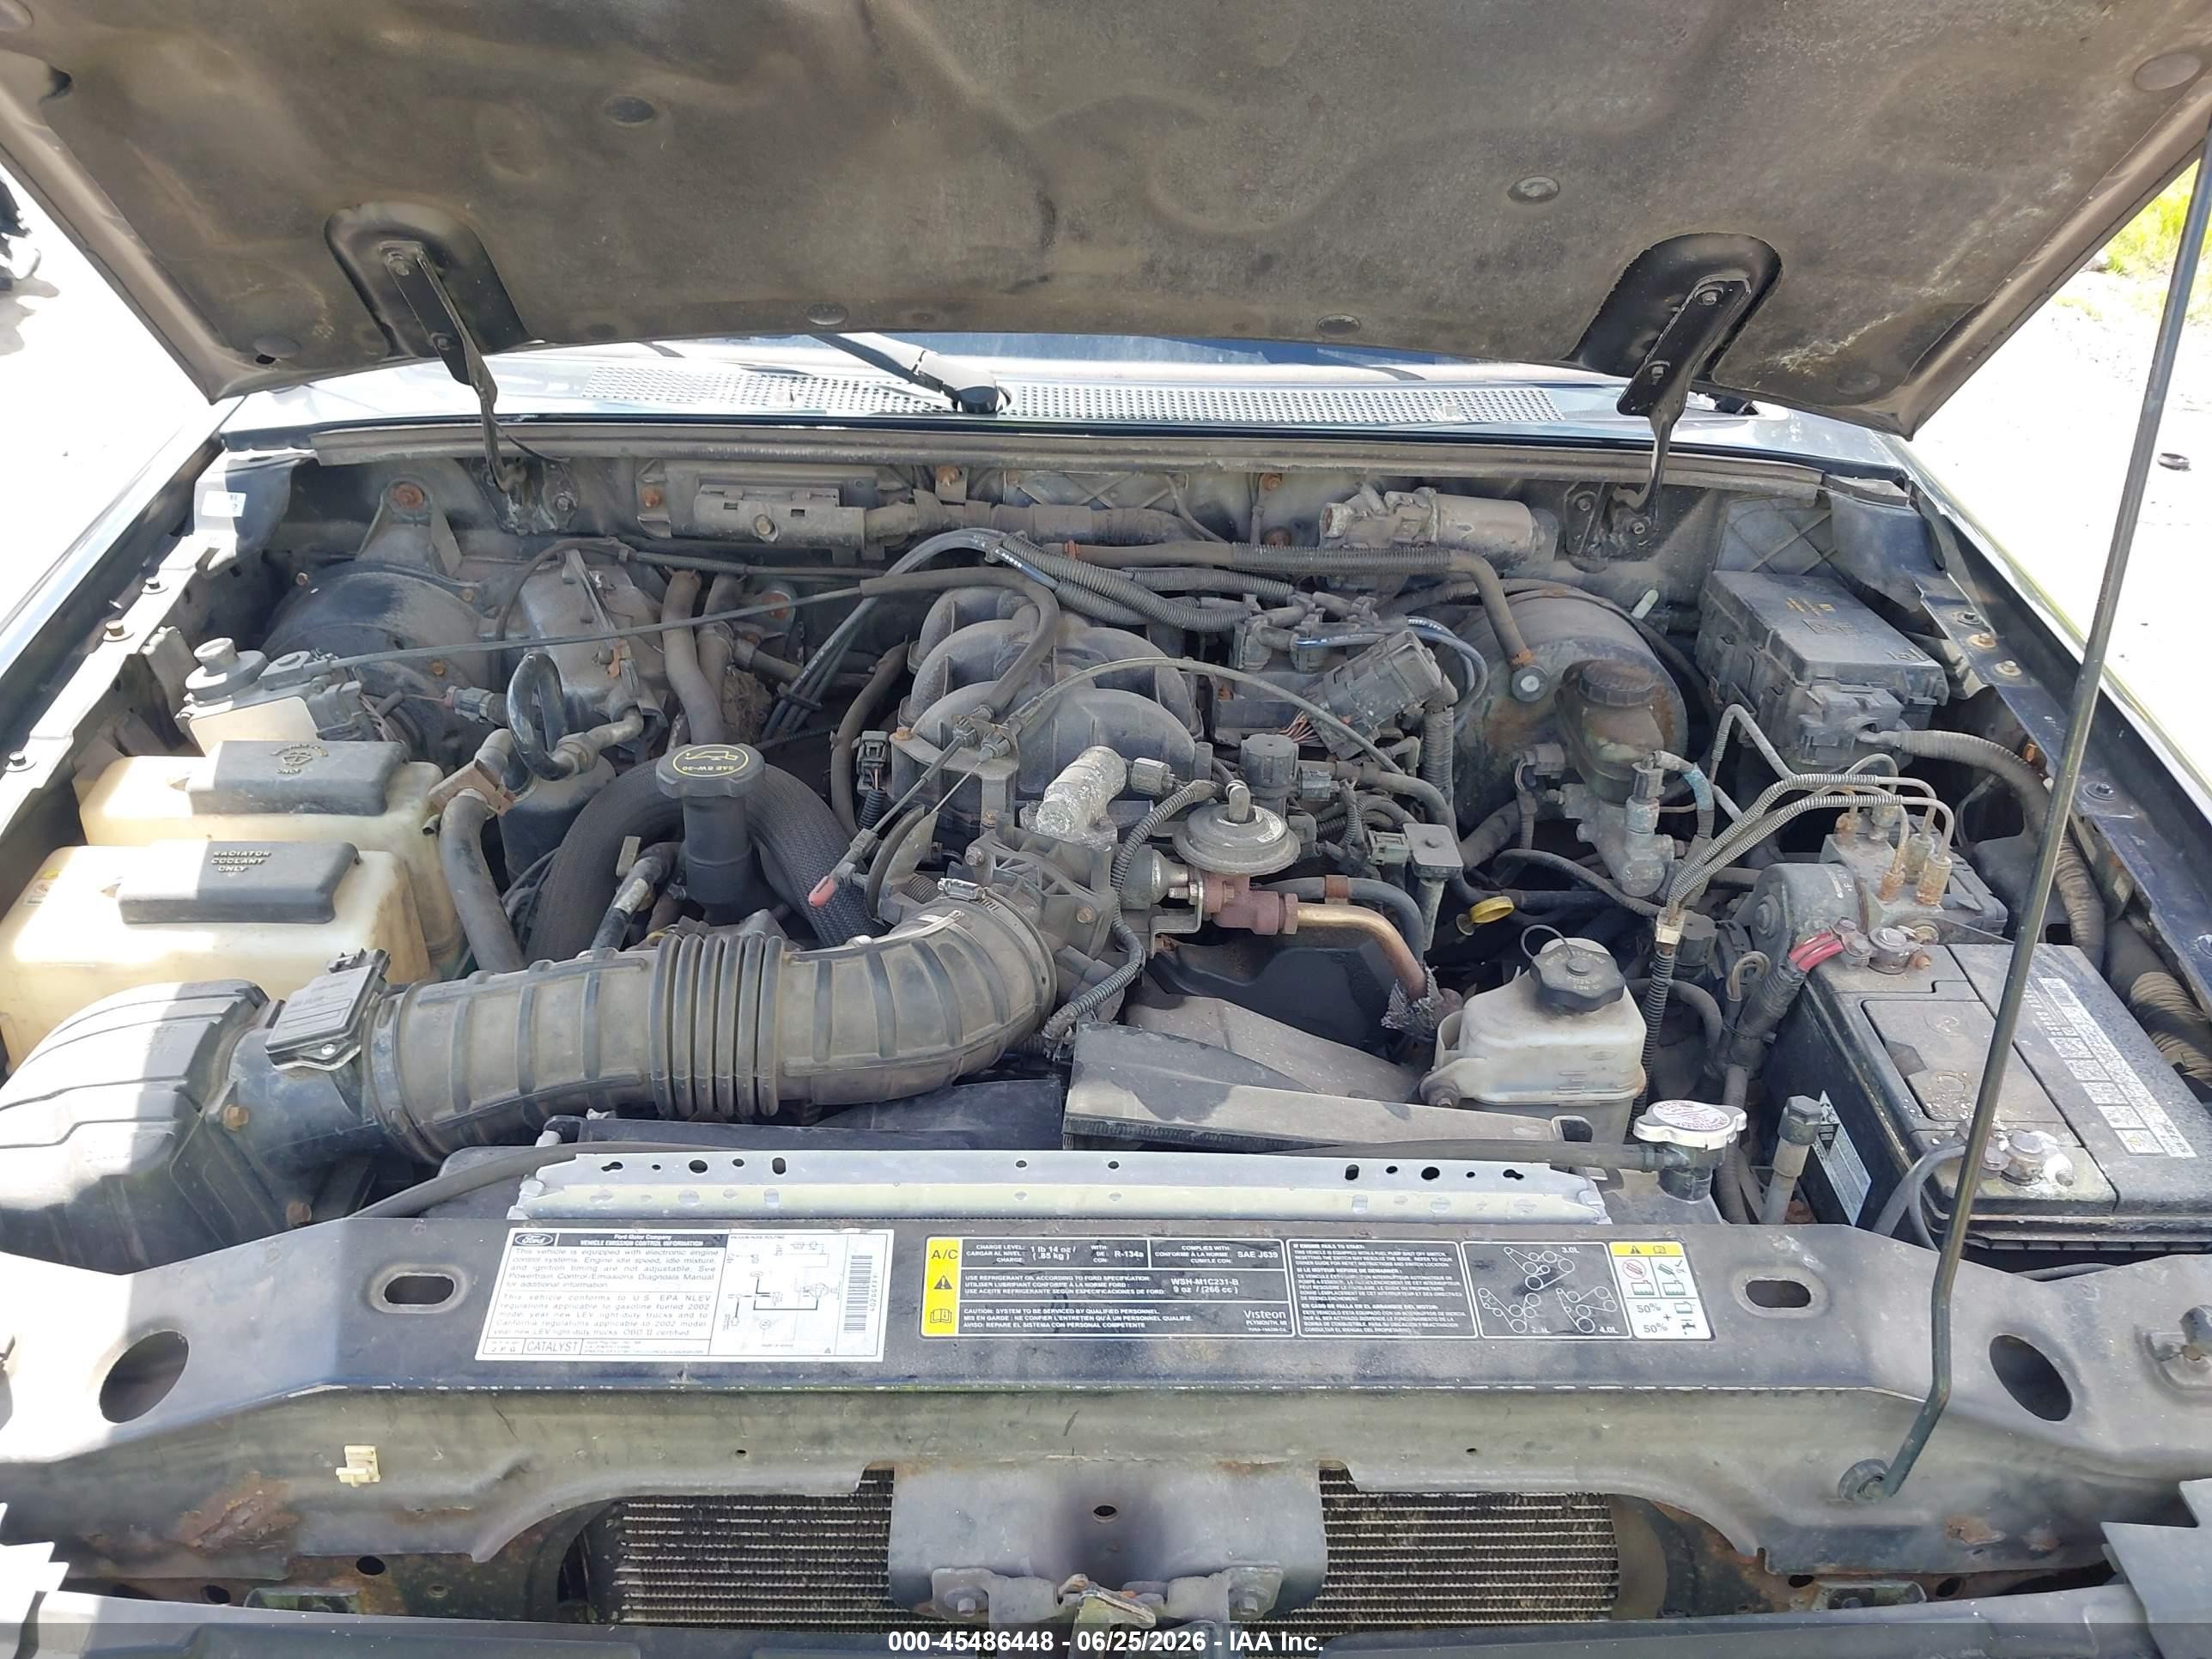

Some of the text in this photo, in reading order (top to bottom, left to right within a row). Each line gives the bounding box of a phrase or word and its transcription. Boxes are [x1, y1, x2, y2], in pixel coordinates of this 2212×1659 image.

[931, 1249, 958, 1260] A/C
[1637, 1303, 1662, 1313] 50%
[1243, 1310, 1286, 1319] Visteon
[1644, 1322, 1668, 1333] 50%
[526, 1341, 578, 1352] CATALYST
